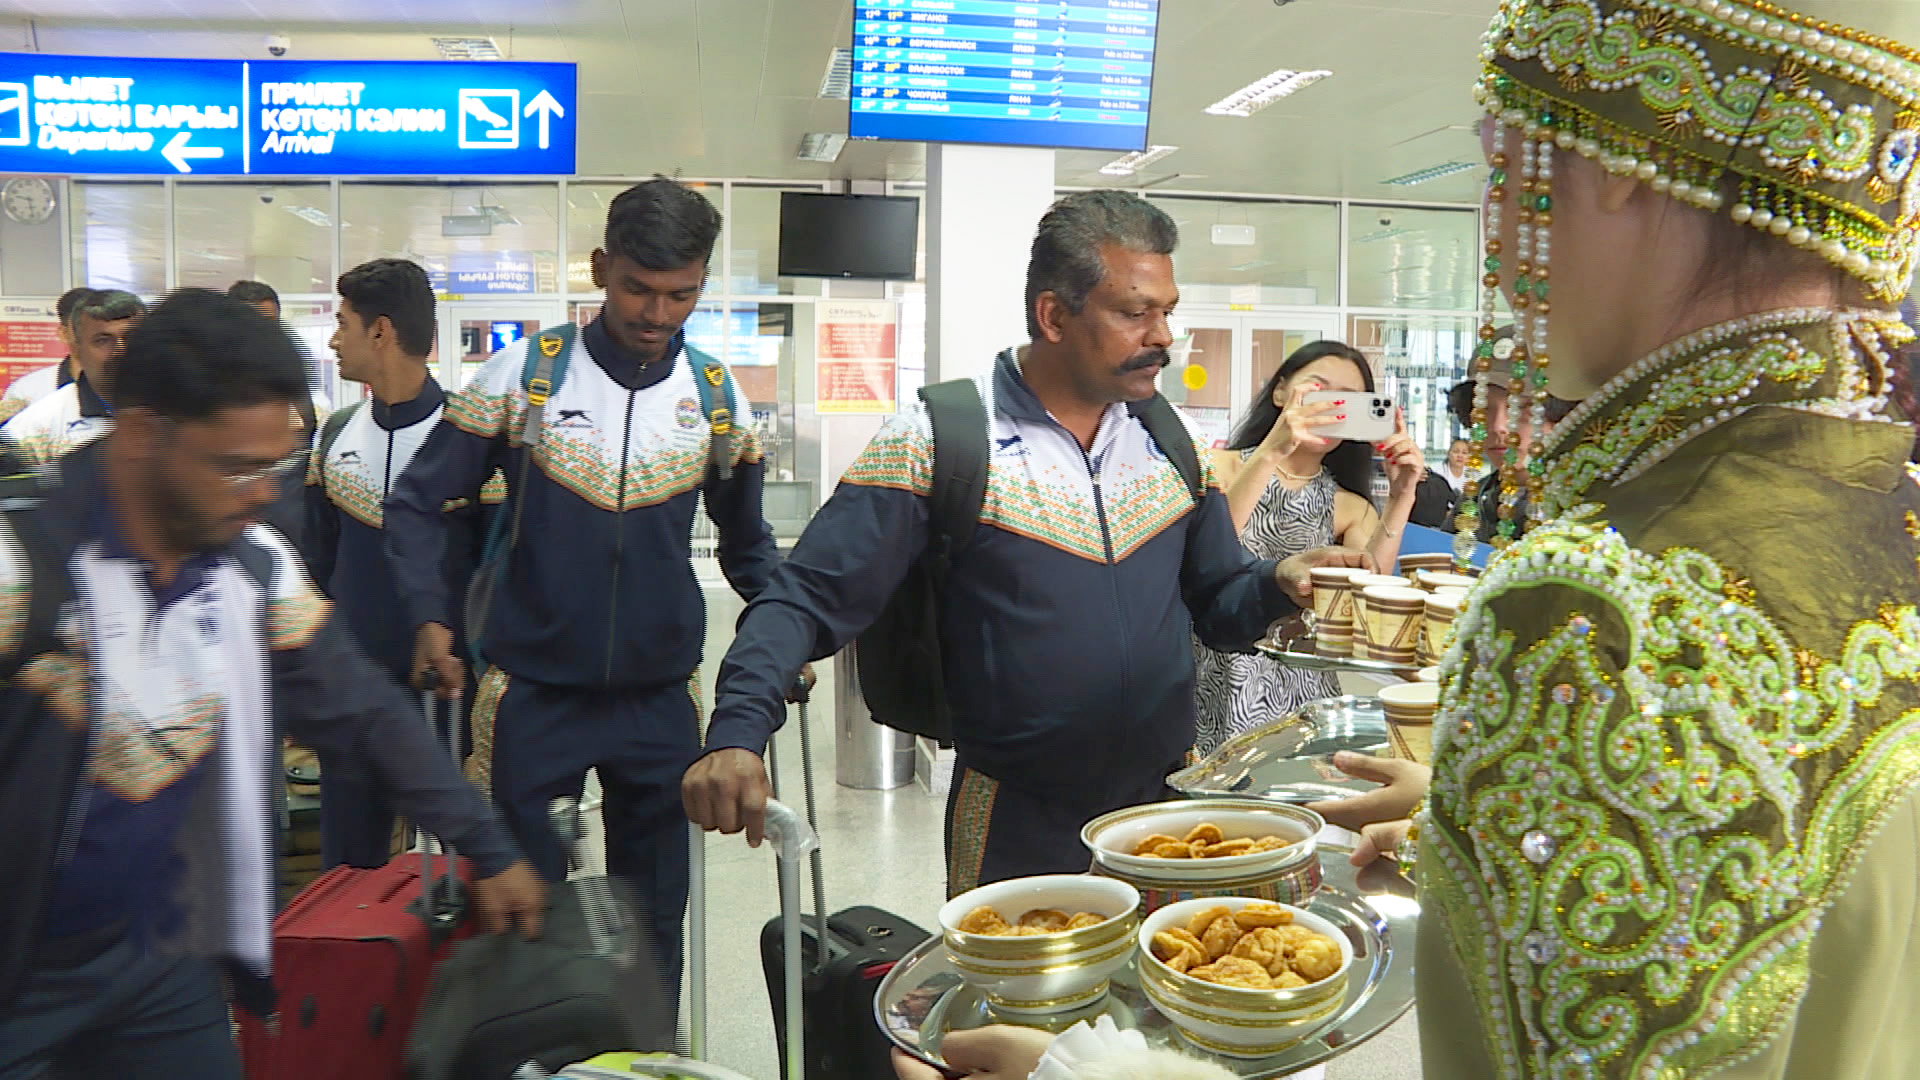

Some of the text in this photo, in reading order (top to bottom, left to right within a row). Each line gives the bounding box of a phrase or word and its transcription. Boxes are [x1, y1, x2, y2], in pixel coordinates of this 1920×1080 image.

[908, 64, 965, 76] ВЛАДИВОСТОК
[34, 75, 134, 102] ВЫЛЕТ
[262, 82, 366, 106] ПРИЛЕТ
[907, 89, 947, 101] ЧОКУРДАХ
[135, 104, 239, 129] БАРЫЫ
[262, 108, 446, 132] КӨТӨН КЭЛИИ
[37, 125, 154, 155] Departure
[261, 131, 336, 154] Arrival
